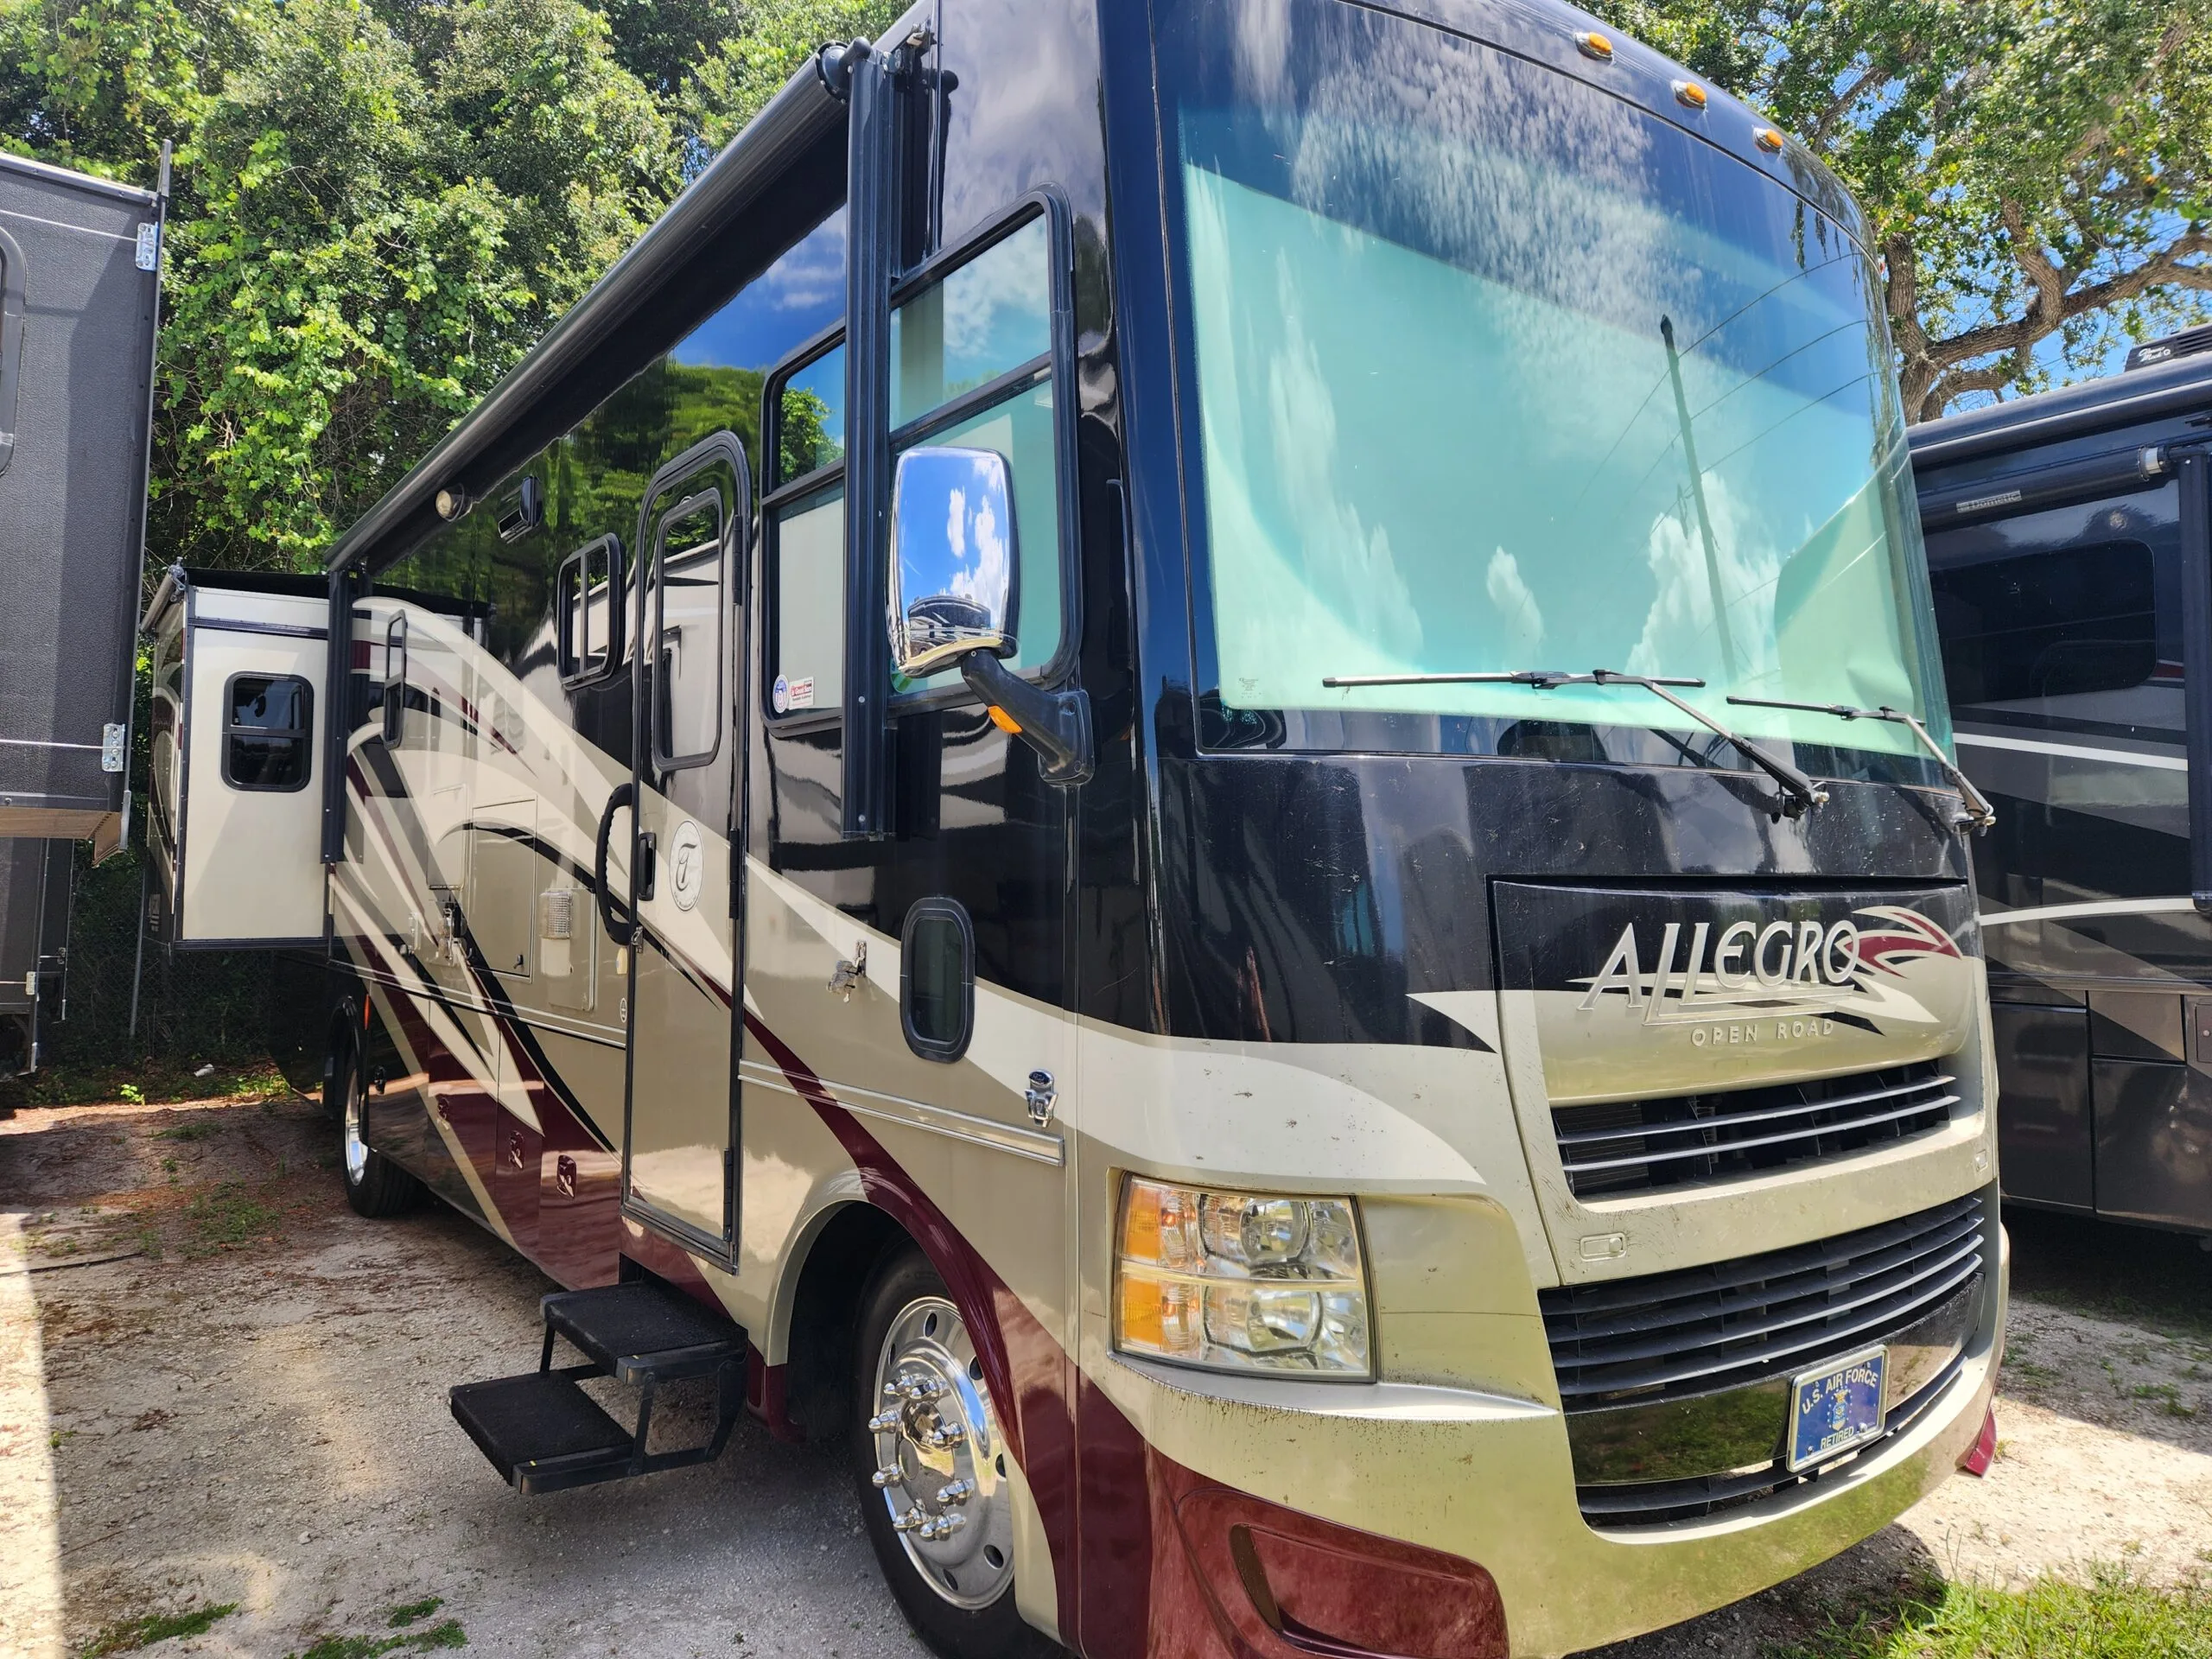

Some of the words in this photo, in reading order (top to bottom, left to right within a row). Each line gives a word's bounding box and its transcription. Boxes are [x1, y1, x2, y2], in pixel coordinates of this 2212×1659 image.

[1973, 494, 2020, 508] Dometic
[1577, 919, 1860, 1026] ALLEGRO
[1690, 1023, 1758, 1047] OPEN
[1776, 1018, 1835, 1039] ROAD
[1802, 1389, 1823, 1414] U.S.
[1825, 1372, 1844, 1394] AIR
[1845, 1368, 1879, 1389] FORCE
[1821, 1426, 1854, 1450] RETIRED
